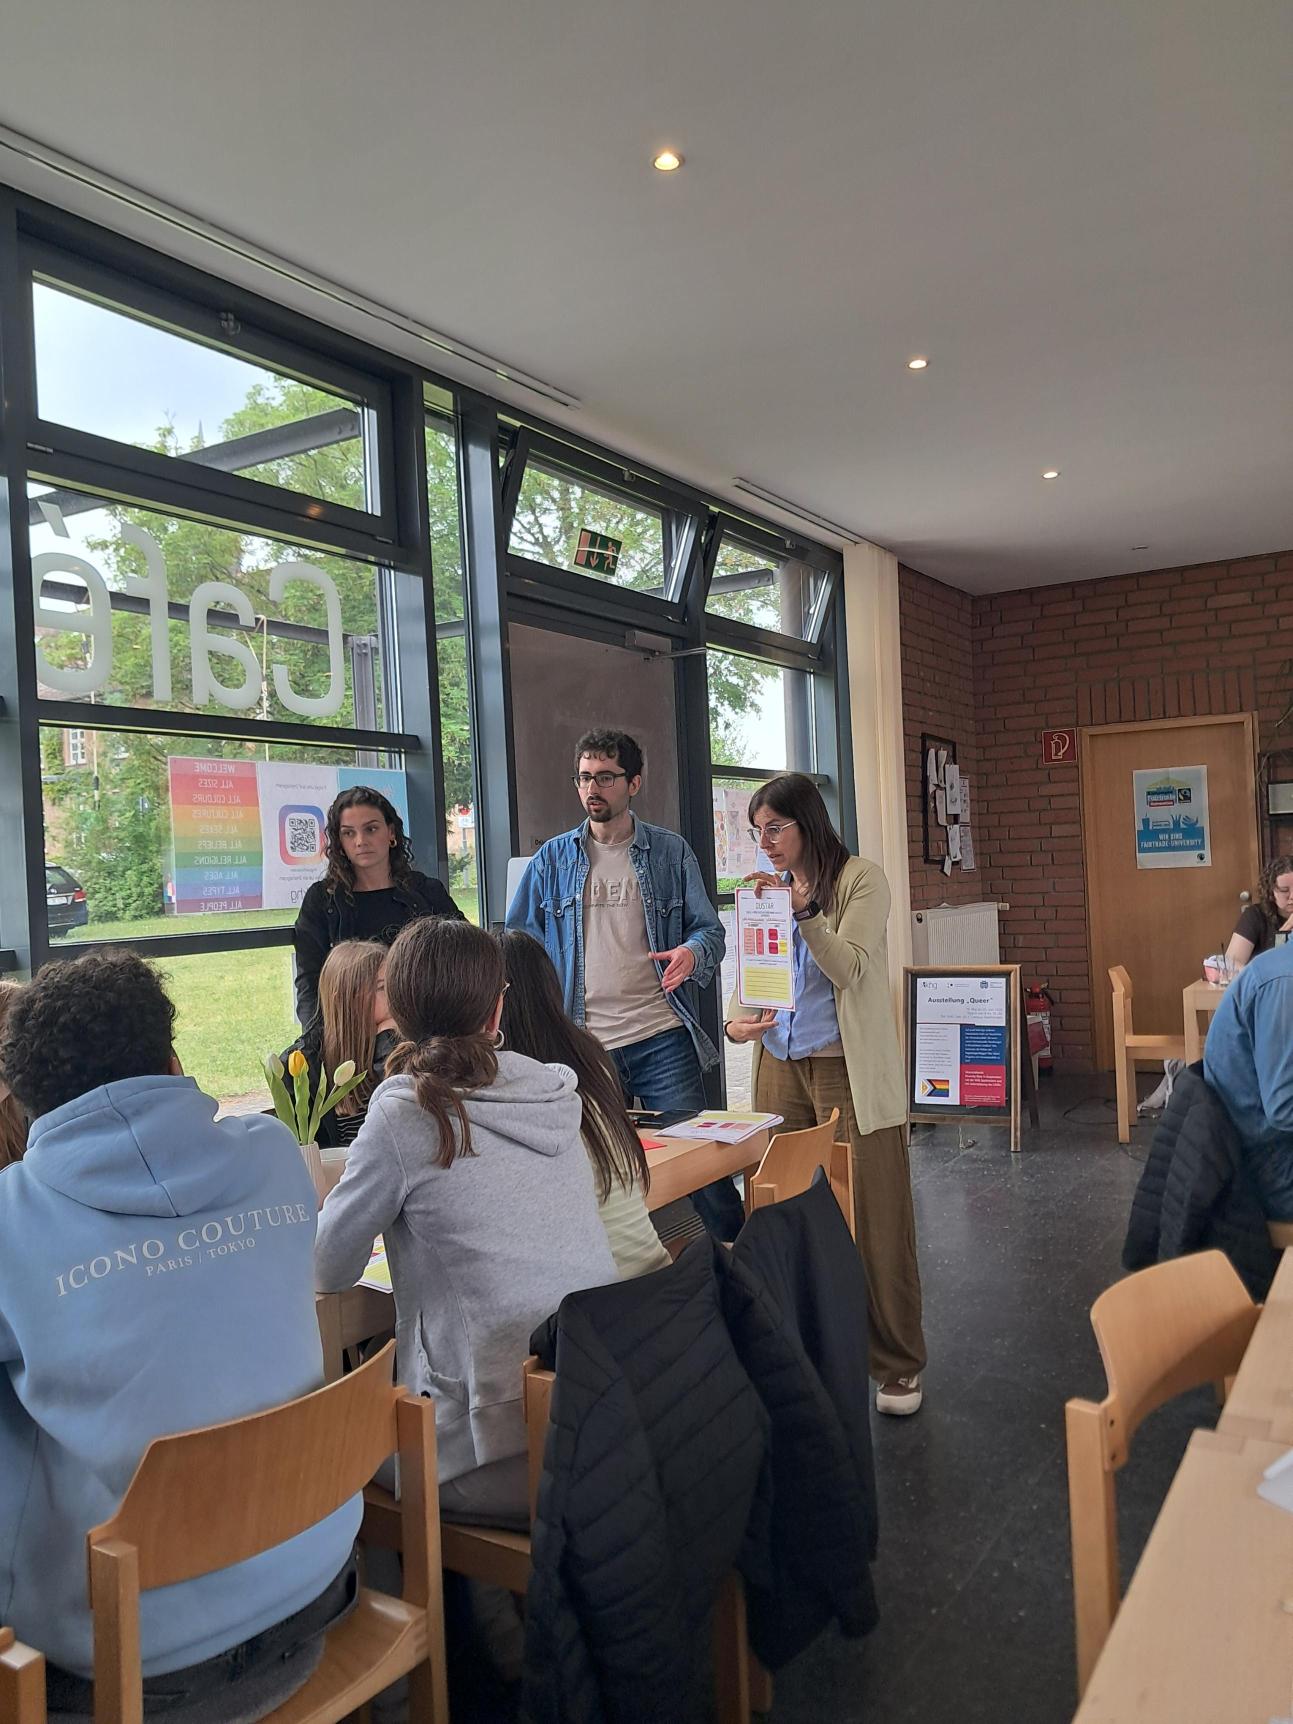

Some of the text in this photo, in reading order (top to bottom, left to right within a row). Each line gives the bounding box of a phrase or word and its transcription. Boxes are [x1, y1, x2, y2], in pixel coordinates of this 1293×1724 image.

[928, 997, 965, 1005] Ausstellung
[56, 1203, 311, 1297] ICONO COUTURE
[145, 1255, 193, 1277] PARIS
[206, 1237, 257, 1259] TOKYO
